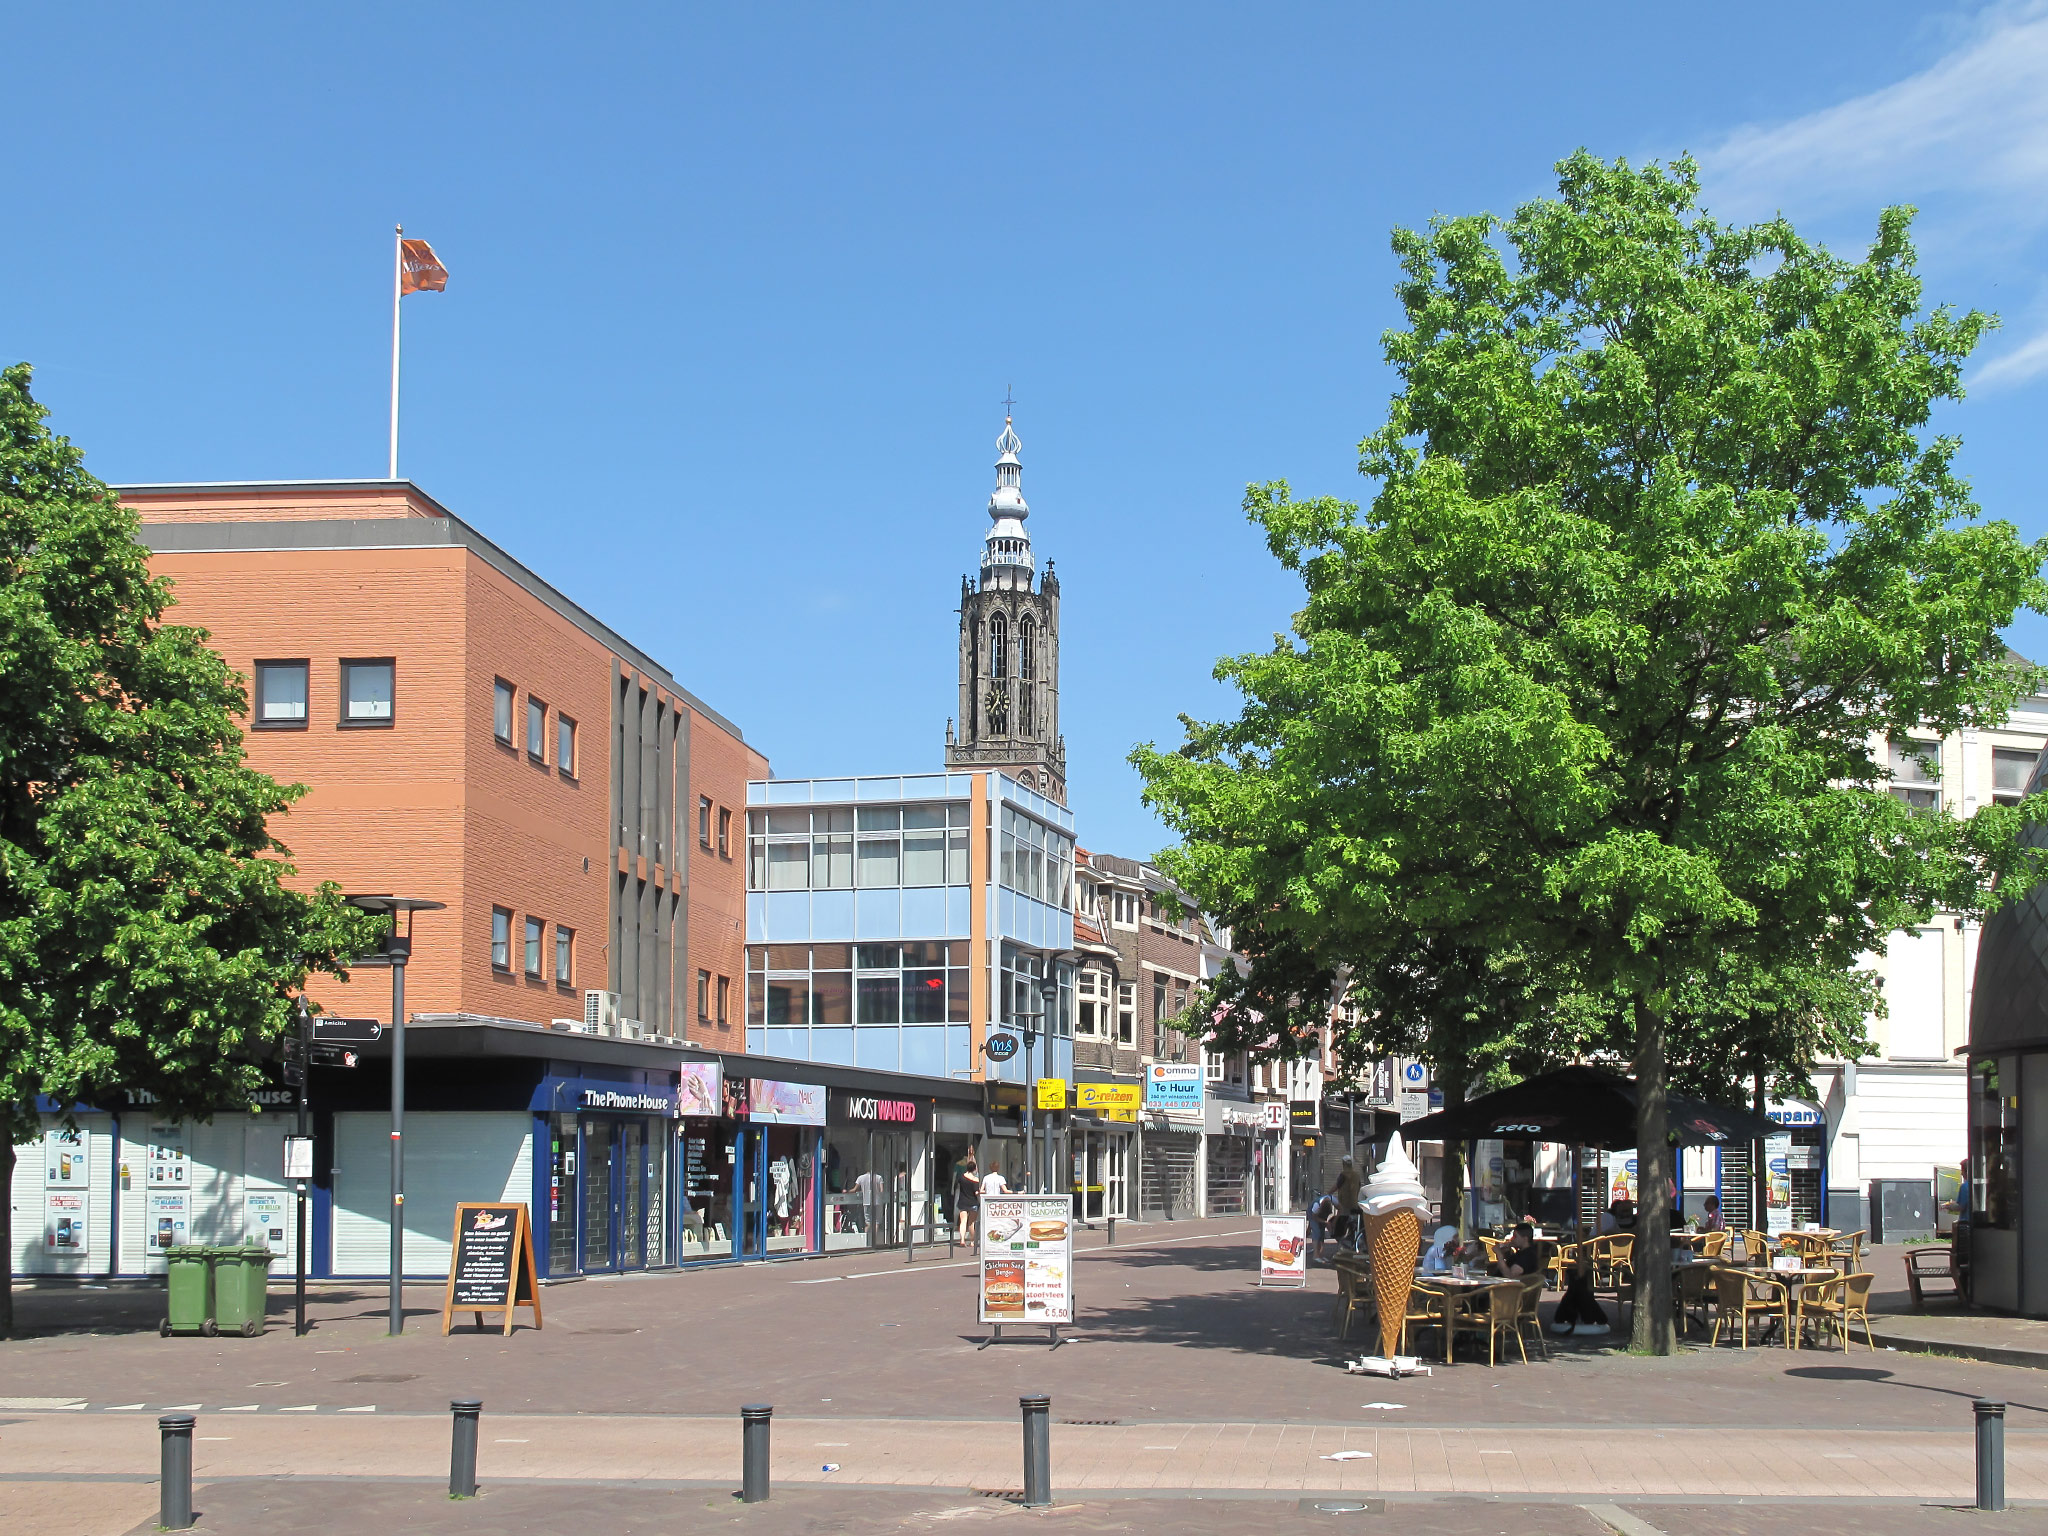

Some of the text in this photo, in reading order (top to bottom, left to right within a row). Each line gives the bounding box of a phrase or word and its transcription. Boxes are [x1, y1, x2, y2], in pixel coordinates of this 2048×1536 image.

[1155, 1083, 1195, 1093] Te Huur
[1766, 1111, 1823, 1125] mpany
[1493, 1124, 1541, 1133] zero
[1030, 1208, 1068, 1216] SANDWICH
[985, 1261, 1009, 1270] Chicken
